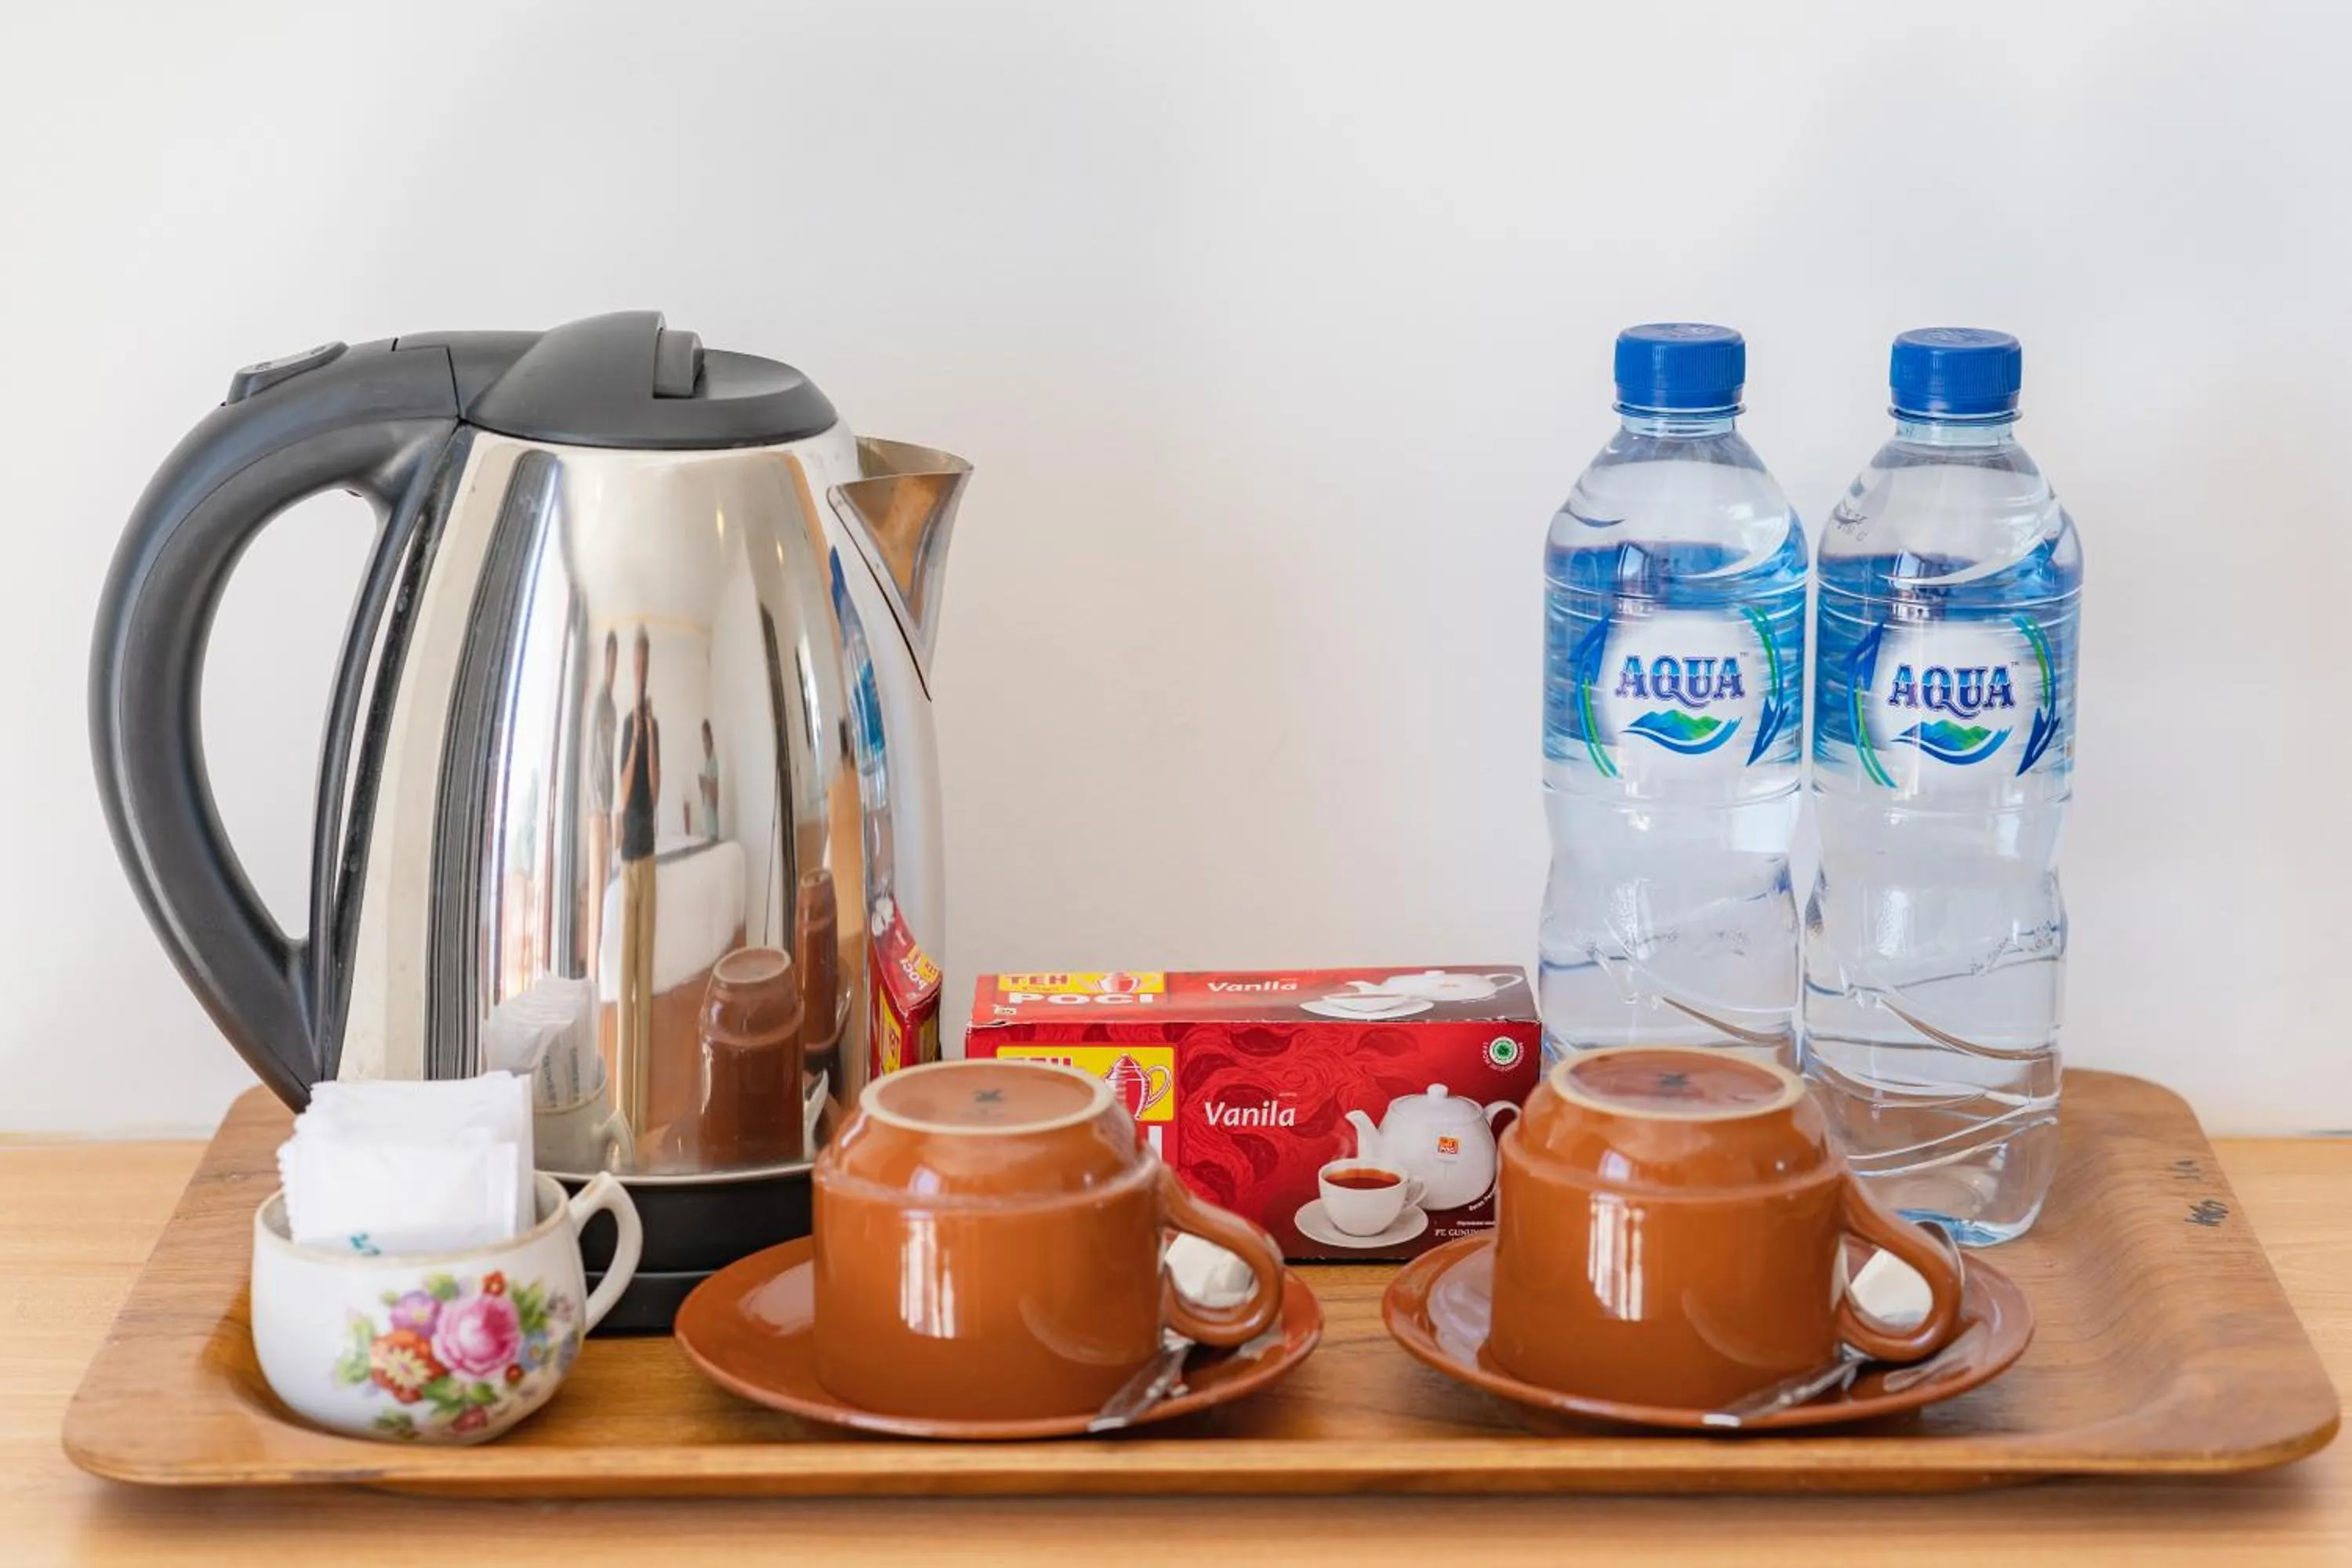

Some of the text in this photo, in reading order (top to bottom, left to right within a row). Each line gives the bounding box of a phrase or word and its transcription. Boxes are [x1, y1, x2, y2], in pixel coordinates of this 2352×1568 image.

[1615, 655, 1745, 709] AQUA
[1887, 664, 2016, 720] AQUA
[1007, 973, 1070, 985] TEH
[1207, 981, 1298, 992] Vanila
[1009, 992, 1154, 1004] POCI
[1204, 1100, 1296, 1127] Vanila
